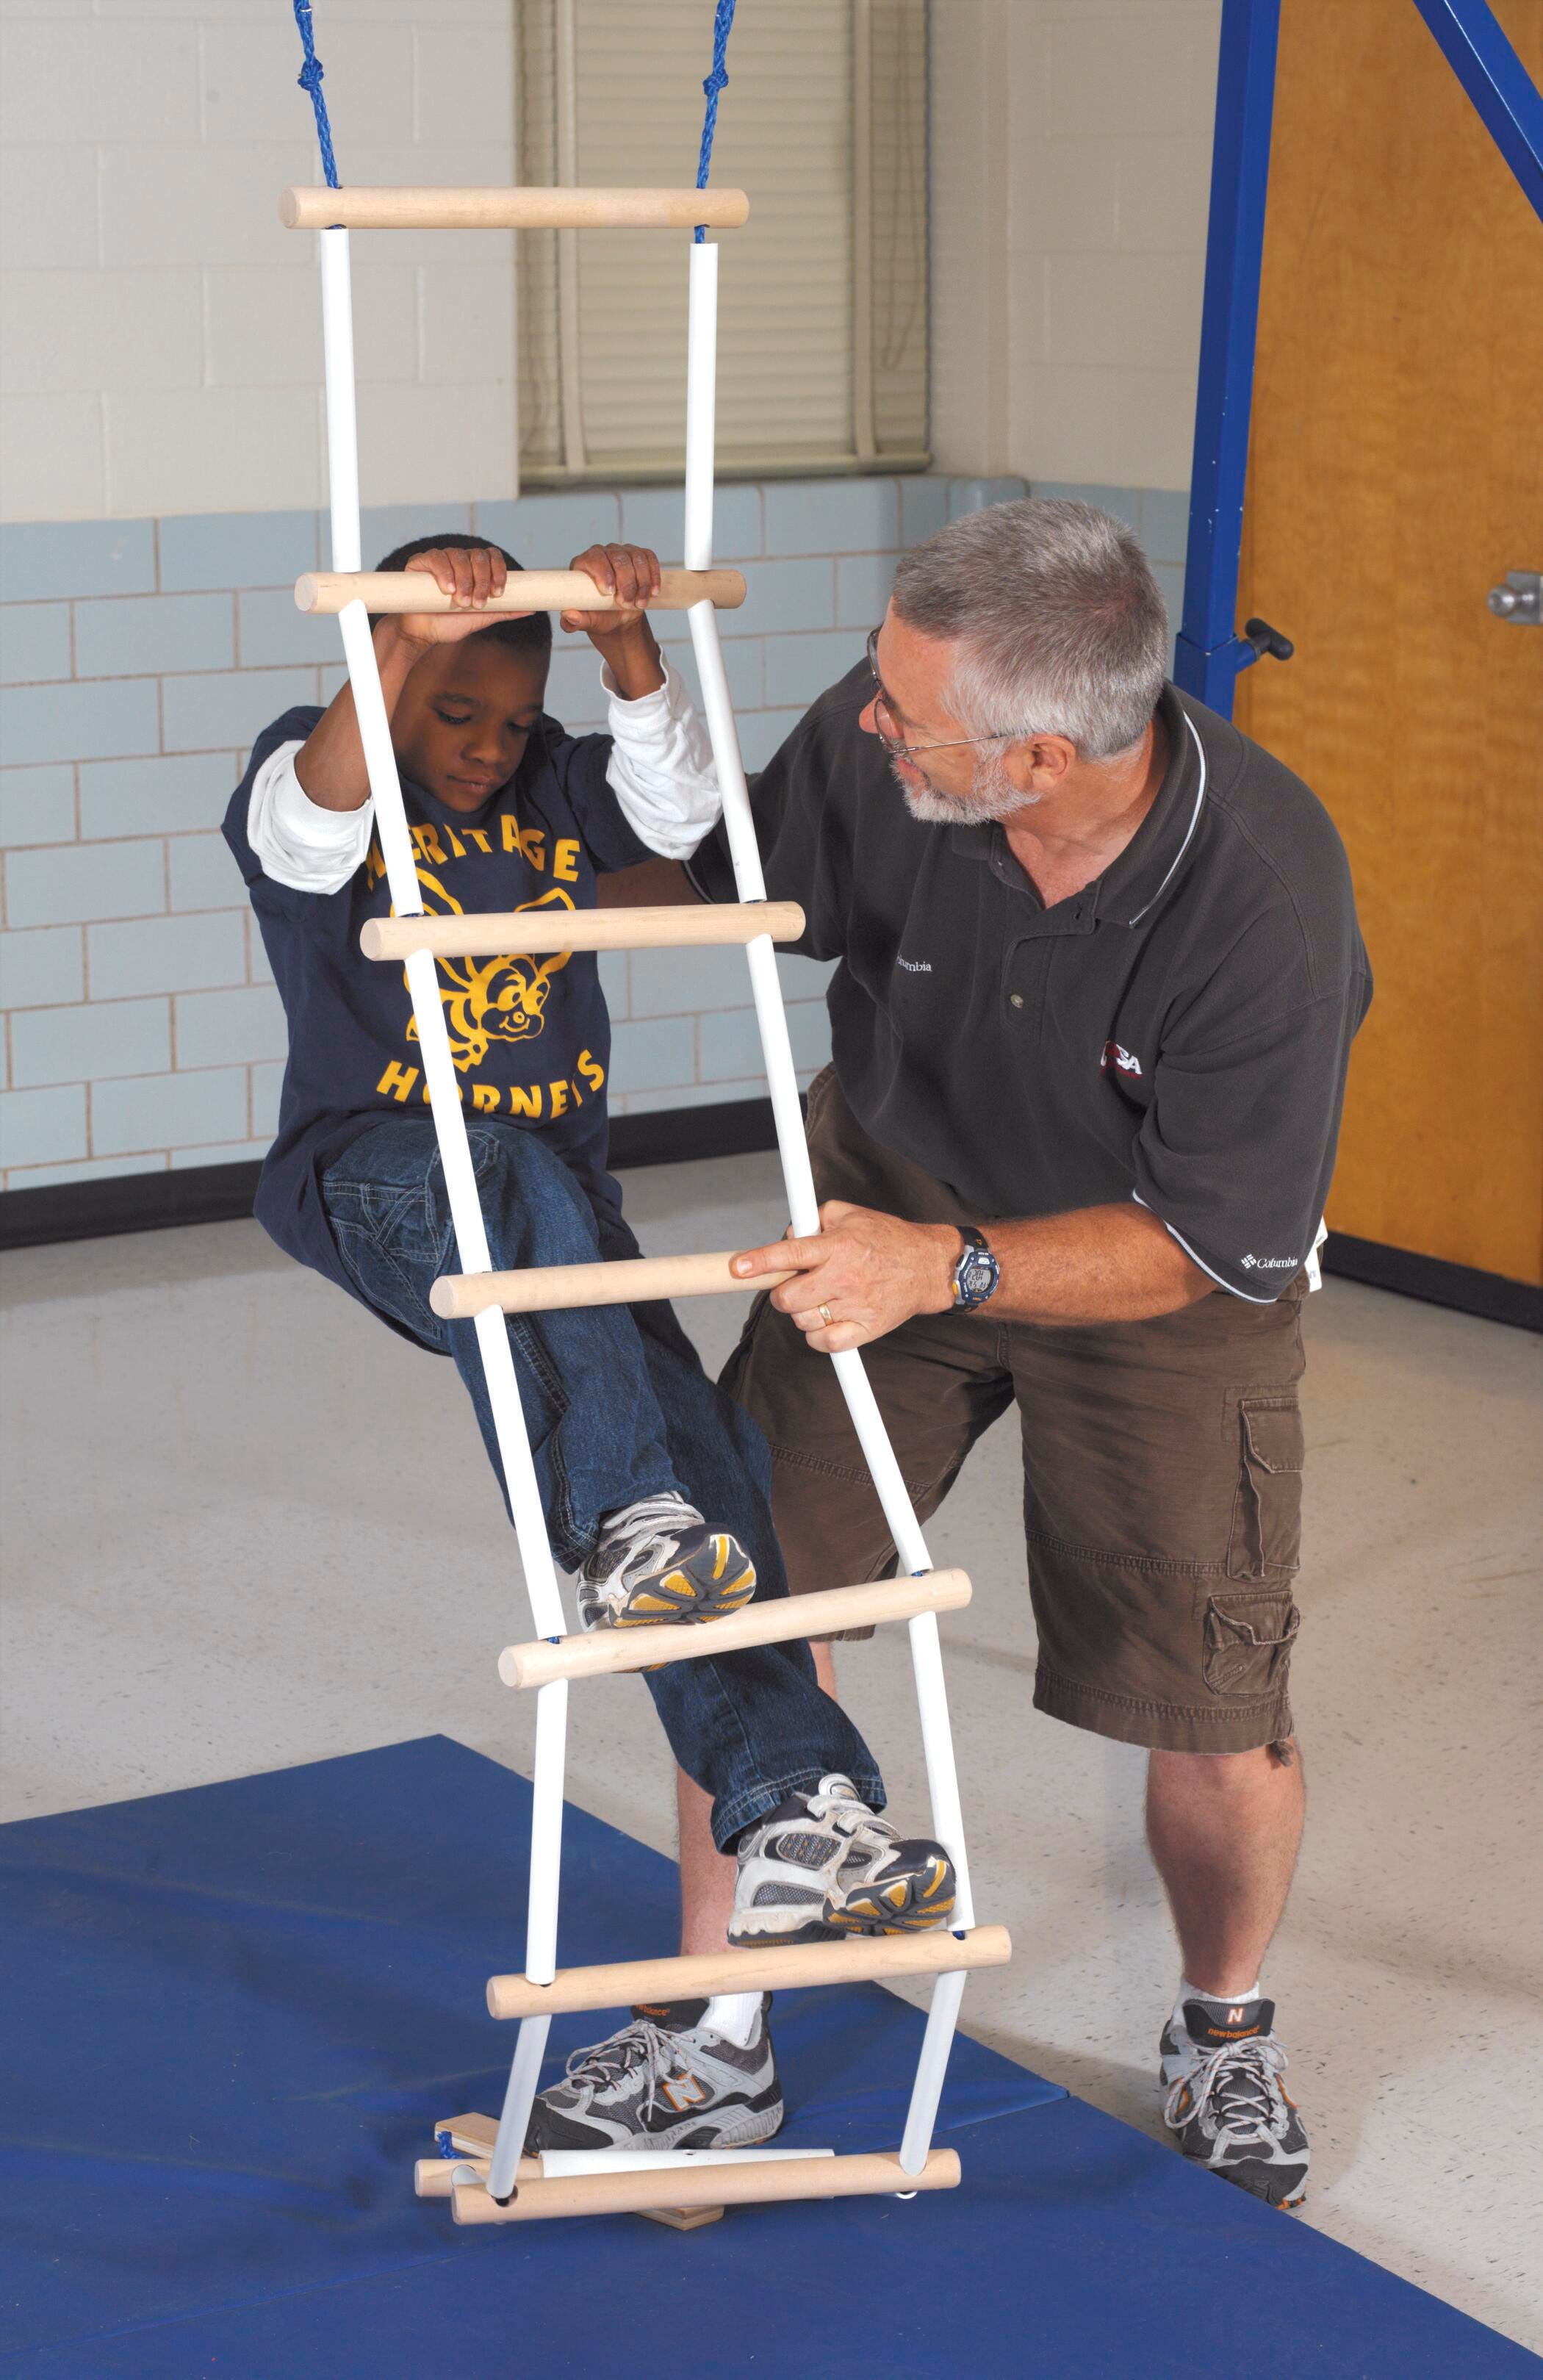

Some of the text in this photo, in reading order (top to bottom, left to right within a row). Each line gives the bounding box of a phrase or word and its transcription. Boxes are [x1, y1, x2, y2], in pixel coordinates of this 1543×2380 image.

[376, 1049, 605, 1119] HRNES
[1256, 1256, 1298, 1268] Columbia
[1226, 2007, 1244, 2024] N
[663, 2071, 705, 2111] N
